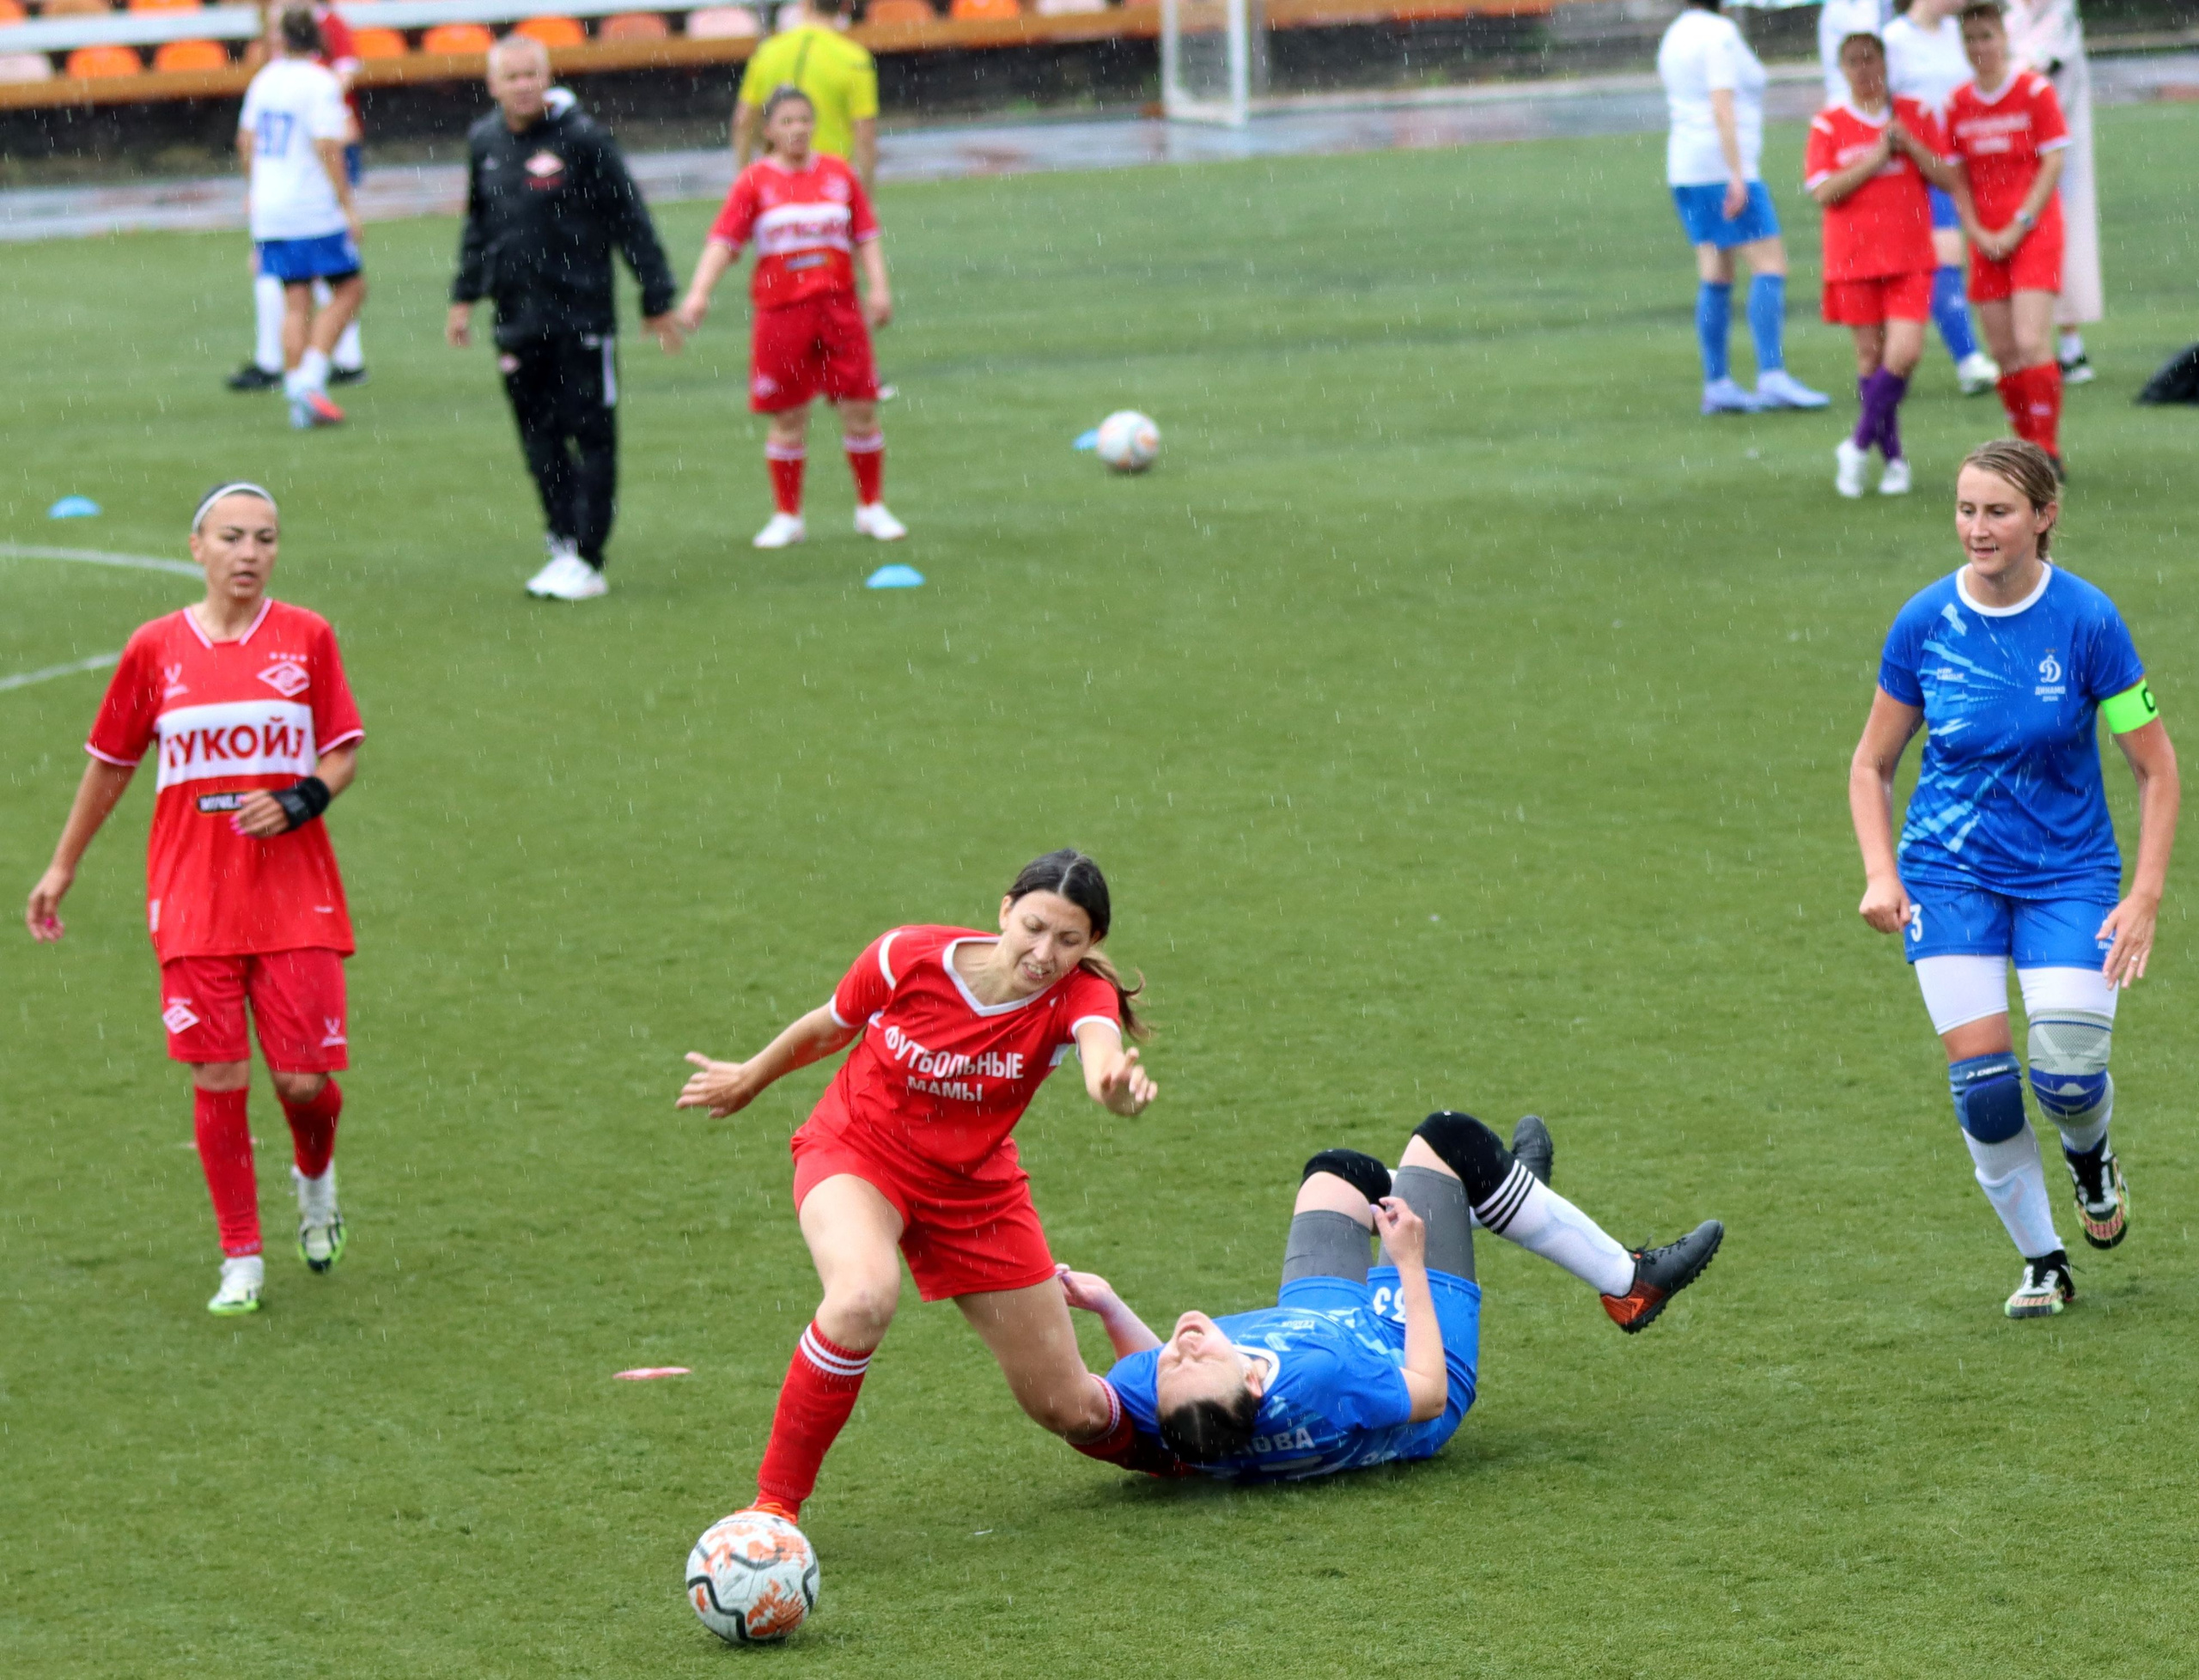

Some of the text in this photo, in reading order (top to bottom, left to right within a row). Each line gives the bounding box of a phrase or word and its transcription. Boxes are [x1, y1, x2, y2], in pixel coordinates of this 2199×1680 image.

[2035, 686, 2066, 696] ДИНАМО
[885, 1025, 1024, 1080] ФУТБОЛЬНЫЕ
[907, 1075, 984, 1102] МАМЫ
